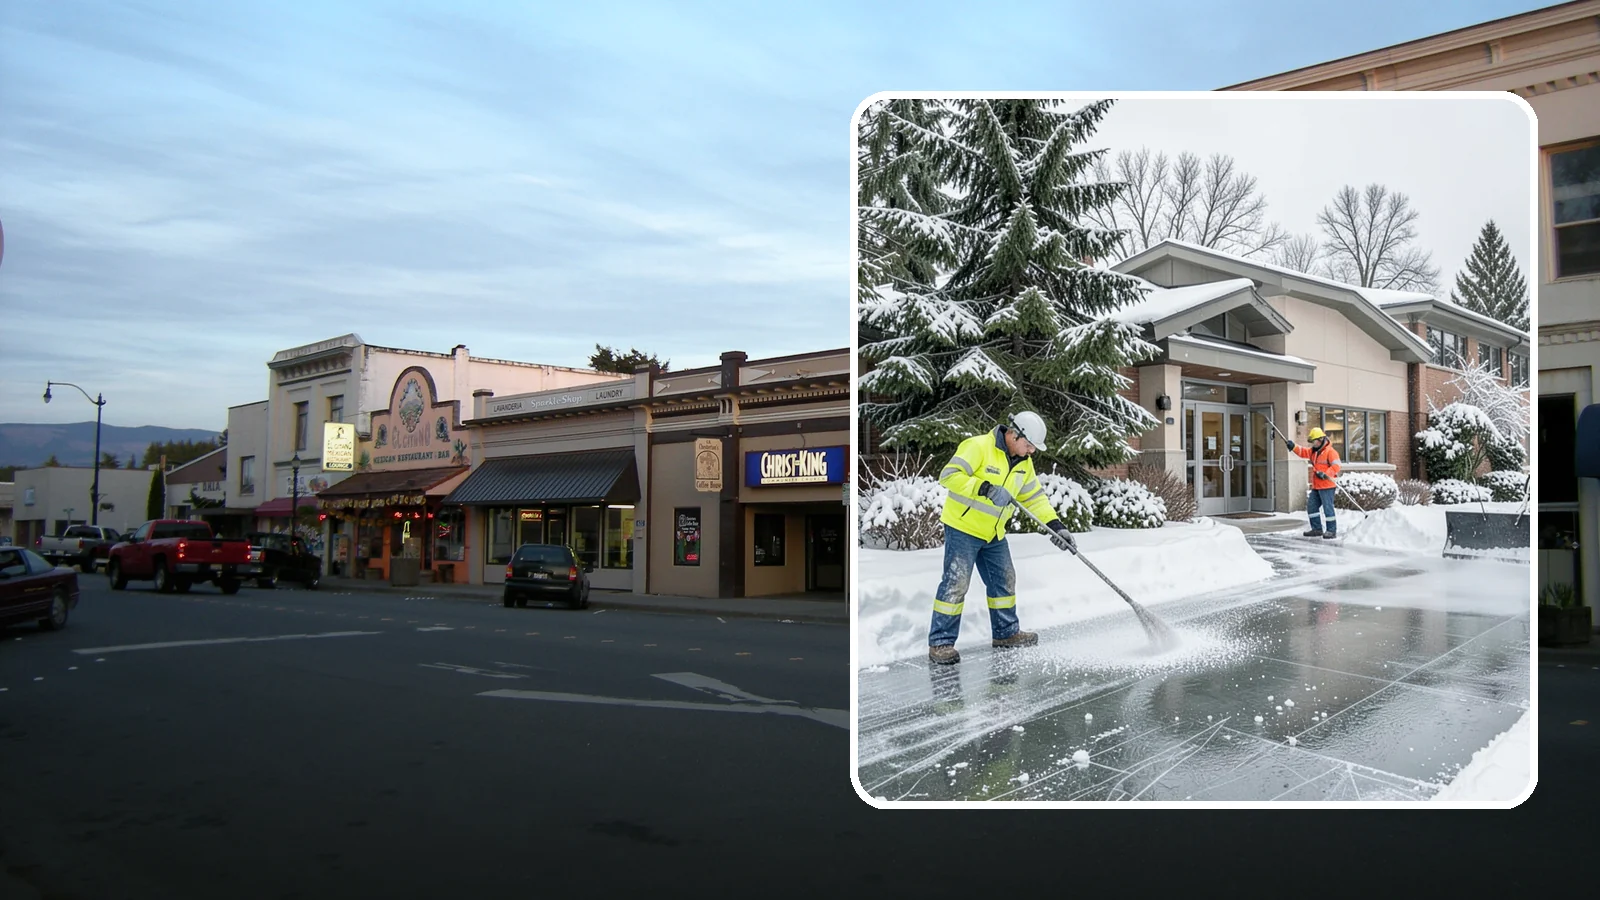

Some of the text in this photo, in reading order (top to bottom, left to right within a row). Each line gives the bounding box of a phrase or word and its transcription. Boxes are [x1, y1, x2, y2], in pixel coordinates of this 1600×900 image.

[493, 388, 623, 412] LAVANDERIA Sparkle Shop LAUNDRY
[373, 450, 450, 464] MEXICAN RESTAURANT BAR
[761, 452, 797, 478] CHRIST
[798, 450, 827, 476] KING
[697, 481, 709, 489] Coffee
